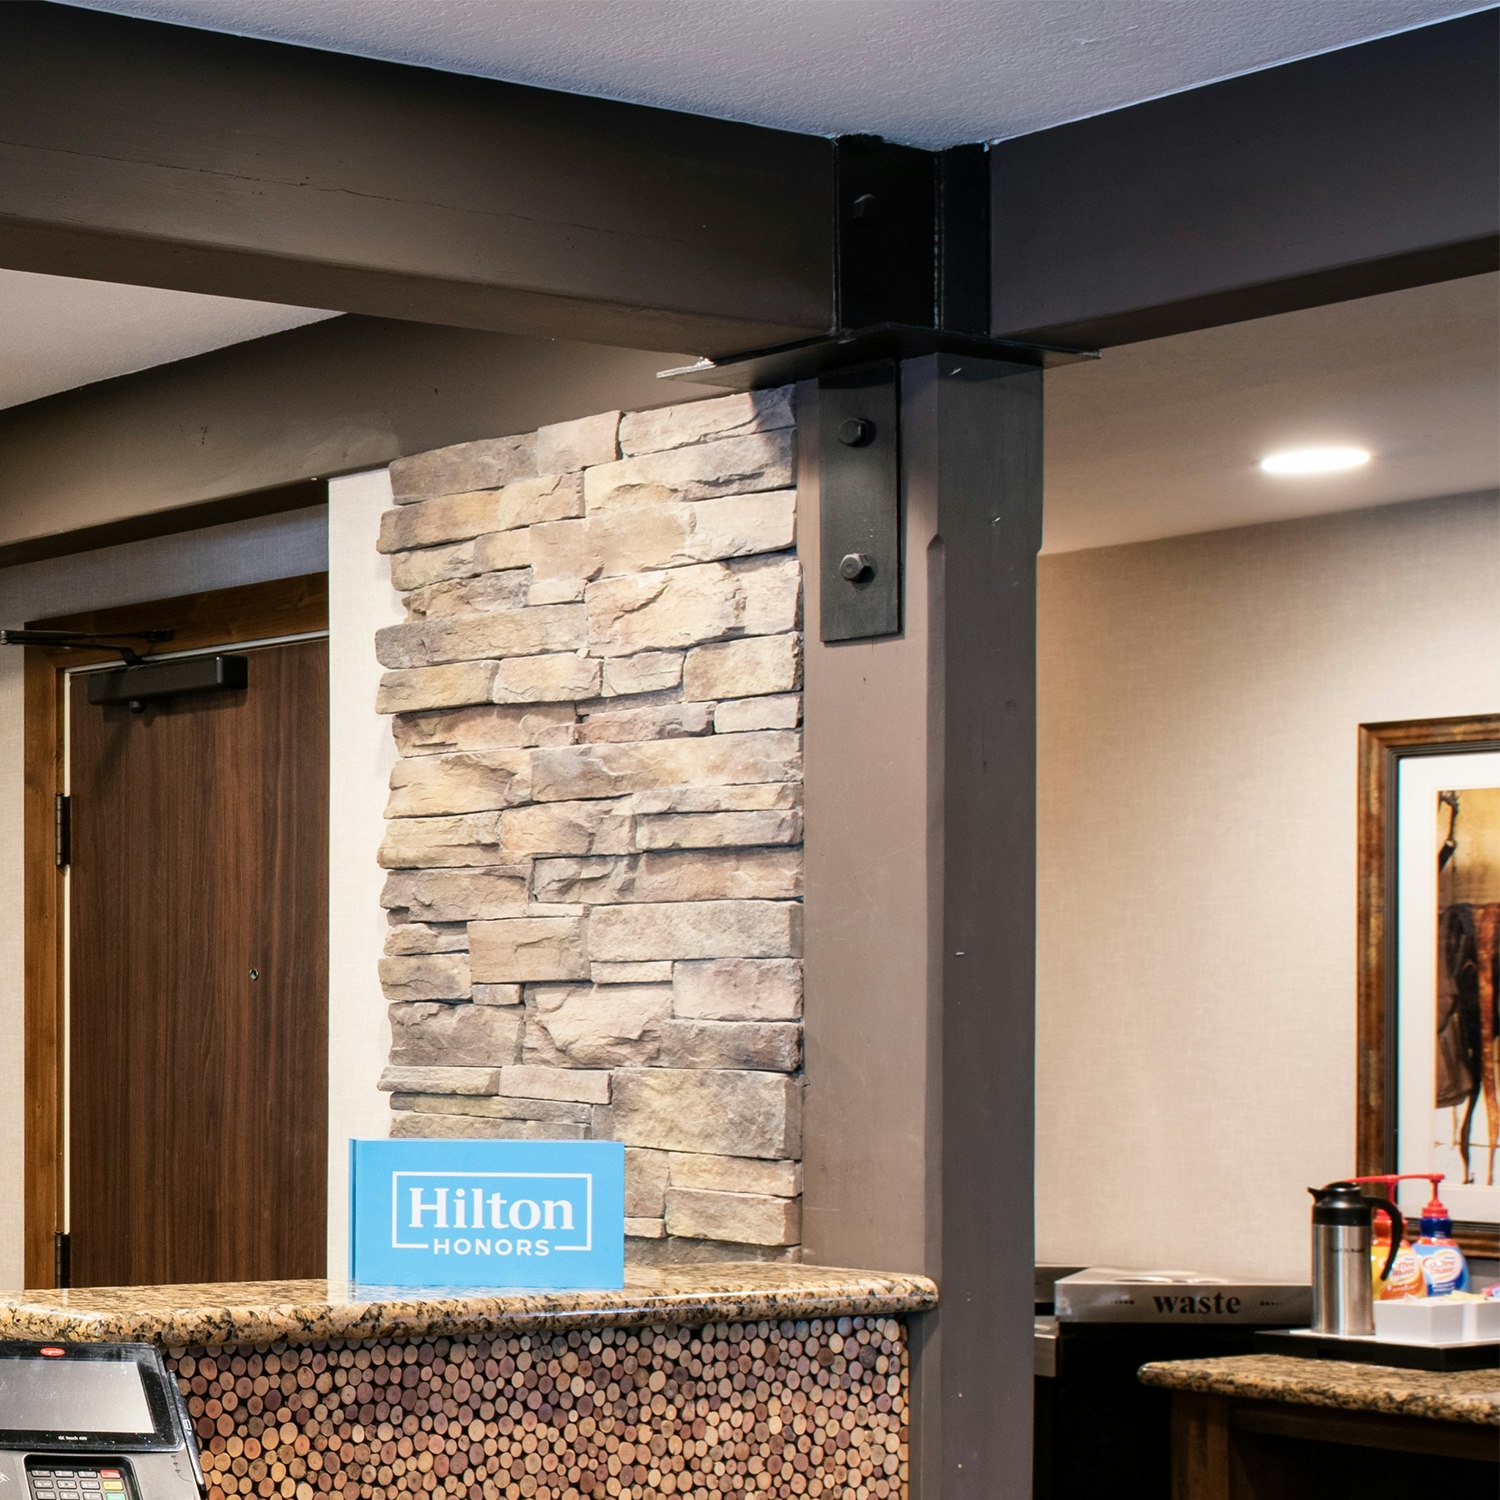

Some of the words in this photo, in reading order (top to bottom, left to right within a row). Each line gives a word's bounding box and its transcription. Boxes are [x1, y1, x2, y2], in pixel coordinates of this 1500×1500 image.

[408, 1187, 575, 1231] Hilton
[433, 1238, 550, 1257] HONORS
[1152, 1291, 1242, 1314] waste
